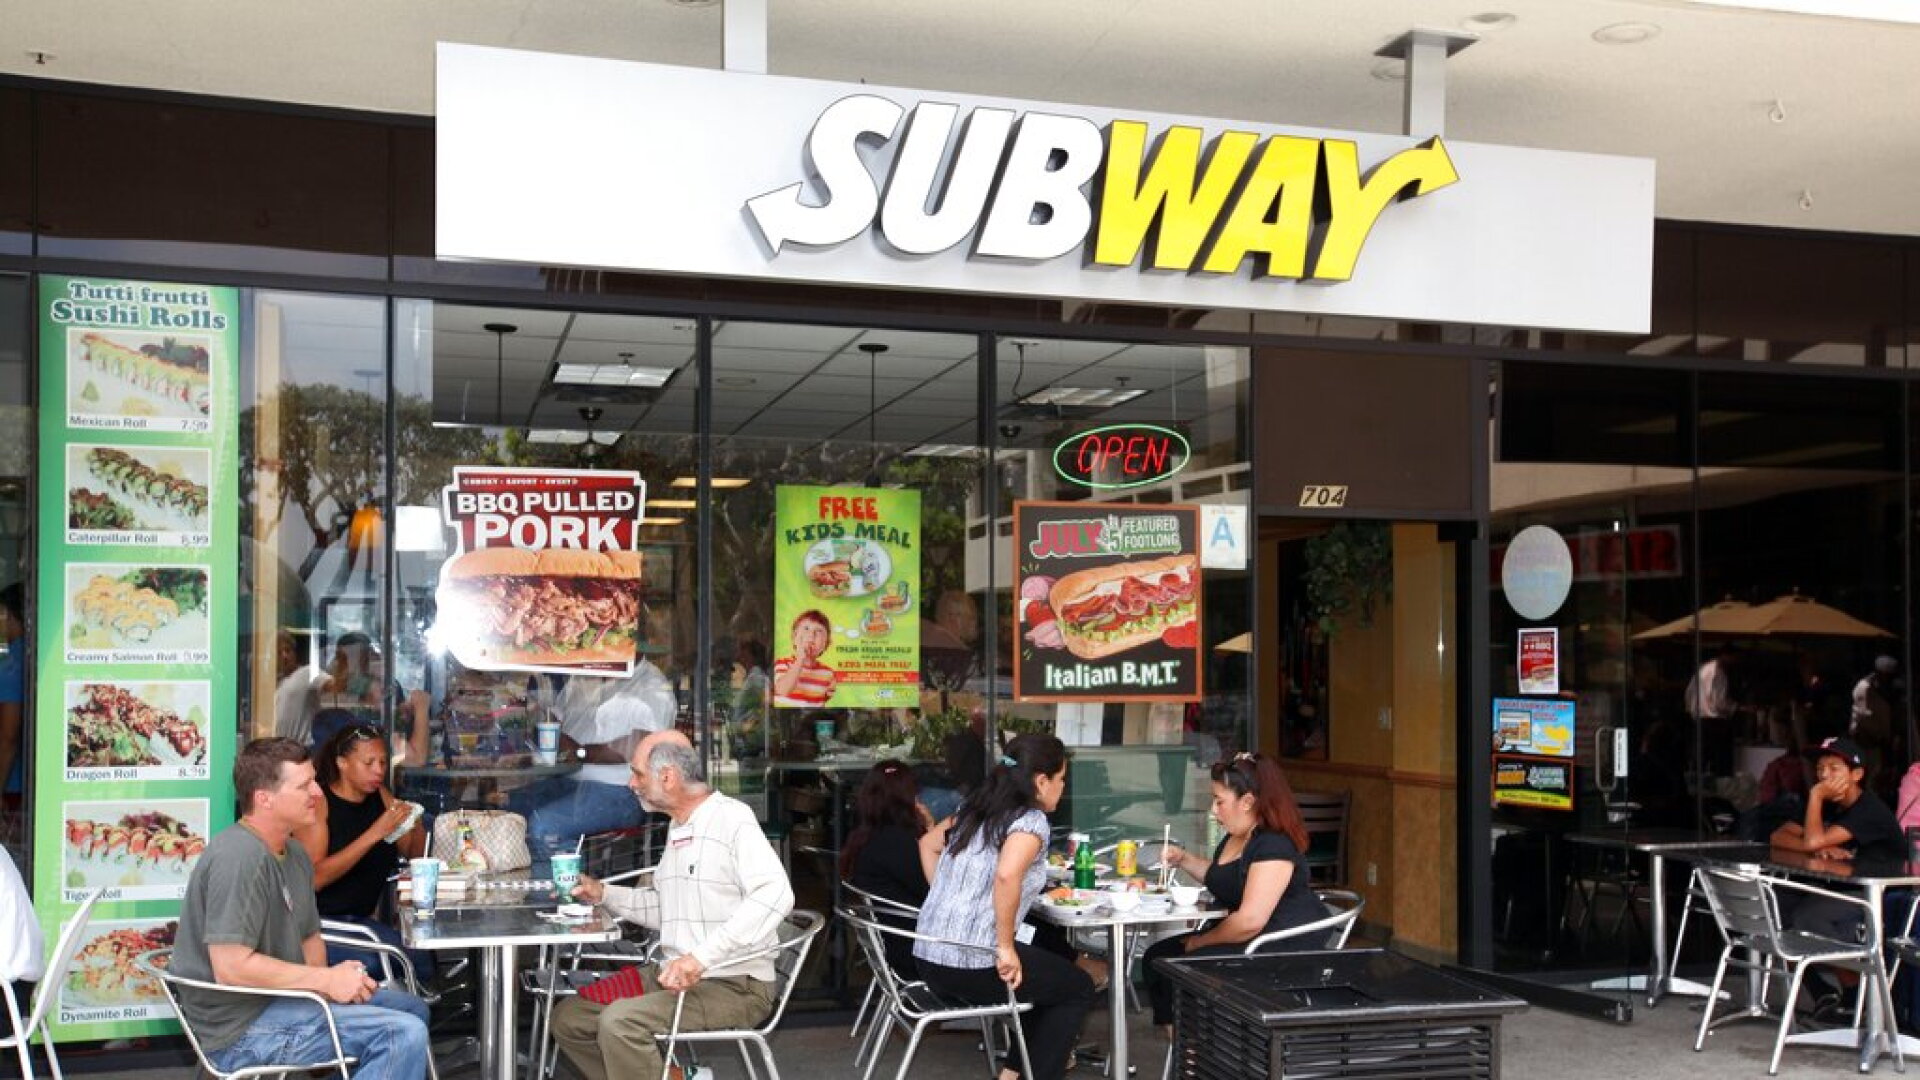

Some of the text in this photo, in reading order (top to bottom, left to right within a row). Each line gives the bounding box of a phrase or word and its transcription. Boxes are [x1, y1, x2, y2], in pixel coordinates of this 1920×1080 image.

[747, 94, 1459, 281] SUBWAY
[70, 281, 209, 305] Tutti frutti
[52, 301, 227, 329] Sushi Rolls
[69, 415, 120, 427] Mexican
[123, 417, 147, 428] Roll
[1076, 434, 1169, 474] OPEN
[456, 490, 635, 515] BBQ PULLED
[819, 496, 879, 521] FREE
[1302, 487, 1345, 506] 704
[475, 513, 622, 551] PORK
[785, 522, 912, 549] KIDS MEAL
[1124, 517, 1177, 533] FEATURED
[1210, 516, 1236, 548] A
[68, 532, 131, 545] Caterpillar
[134, 533, 159, 543] Roll
[1033, 523, 1104, 556] JULY
[1124, 533, 1180, 549] FOOTLONG
[67, 651, 109, 663] Creamy
[112, 652, 155, 661] Salmon
[157, 651, 177, 661] Roll
[1045, 662, 1118, 689] Italian
[67, 769, 112, 781] Dragon
[113, 768, 138, 779] Roll
[64, 890, 92, 902] Tige
[61, 1007, 147, 1024] Dynamite Roll
